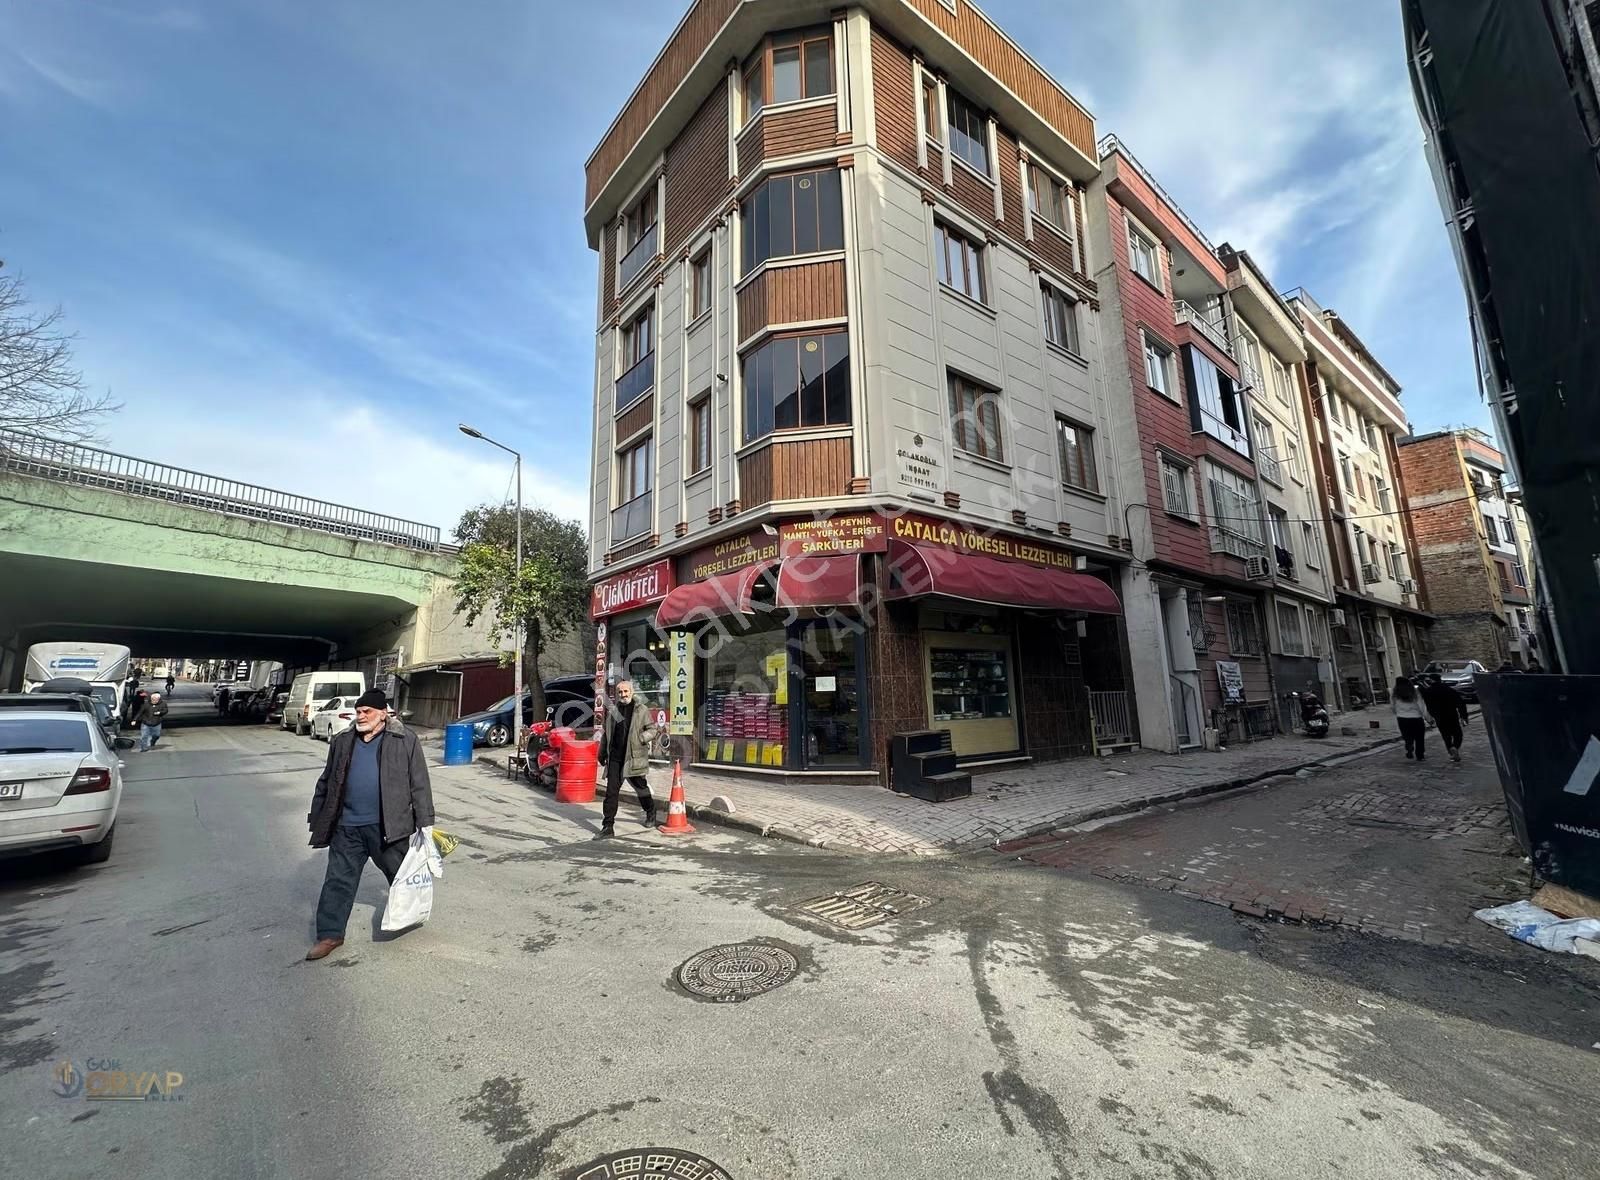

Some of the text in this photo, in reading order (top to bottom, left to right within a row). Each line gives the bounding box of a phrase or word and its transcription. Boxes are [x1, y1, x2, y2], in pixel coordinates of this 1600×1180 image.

[793, 520, 833, 530] YUMURTA
[840, 516, 872, 527] PEYNİR
[783, 531, 810, 541] MANTI
[816, 528, 845, 538] YUFKA
[894, 517, 1073, 569] ÇATALCA YÖRESEL LEZZETLERİ
[714, 536, 751, 558] ÇATALCA
[693, 541, 778, 579] YÖRESEL LEZZETLERİ
[1, 784, 18, 796] 01
